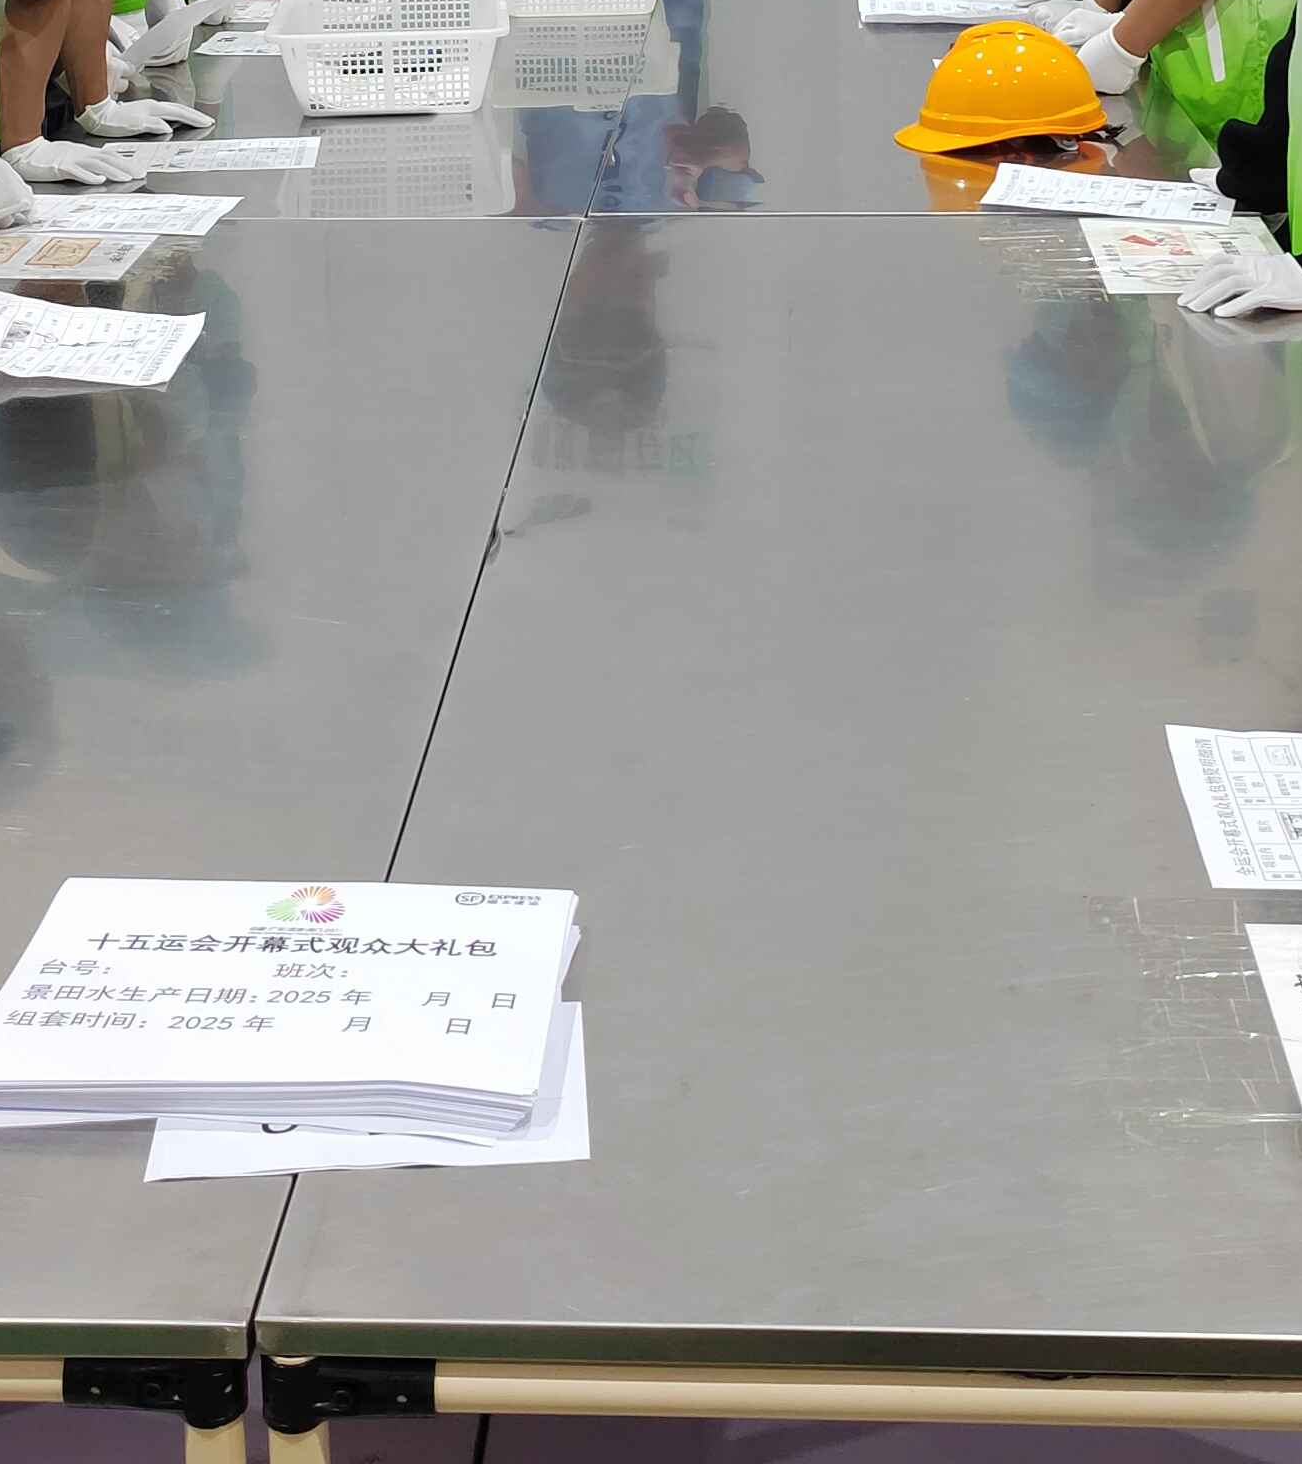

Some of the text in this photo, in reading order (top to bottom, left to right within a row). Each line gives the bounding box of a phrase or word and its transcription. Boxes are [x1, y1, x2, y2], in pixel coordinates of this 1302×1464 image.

[86, 933, 498, 957] 十五运会开幕式观众大礼包
[39, 959, 349, 979] 台号： 班次：
[422, 991, 451, 1007] 月
[491, 992, 517, 1009] 日
[341, 1016, 371, 1033] 月
[445, 1018, 472, 1035] 日
